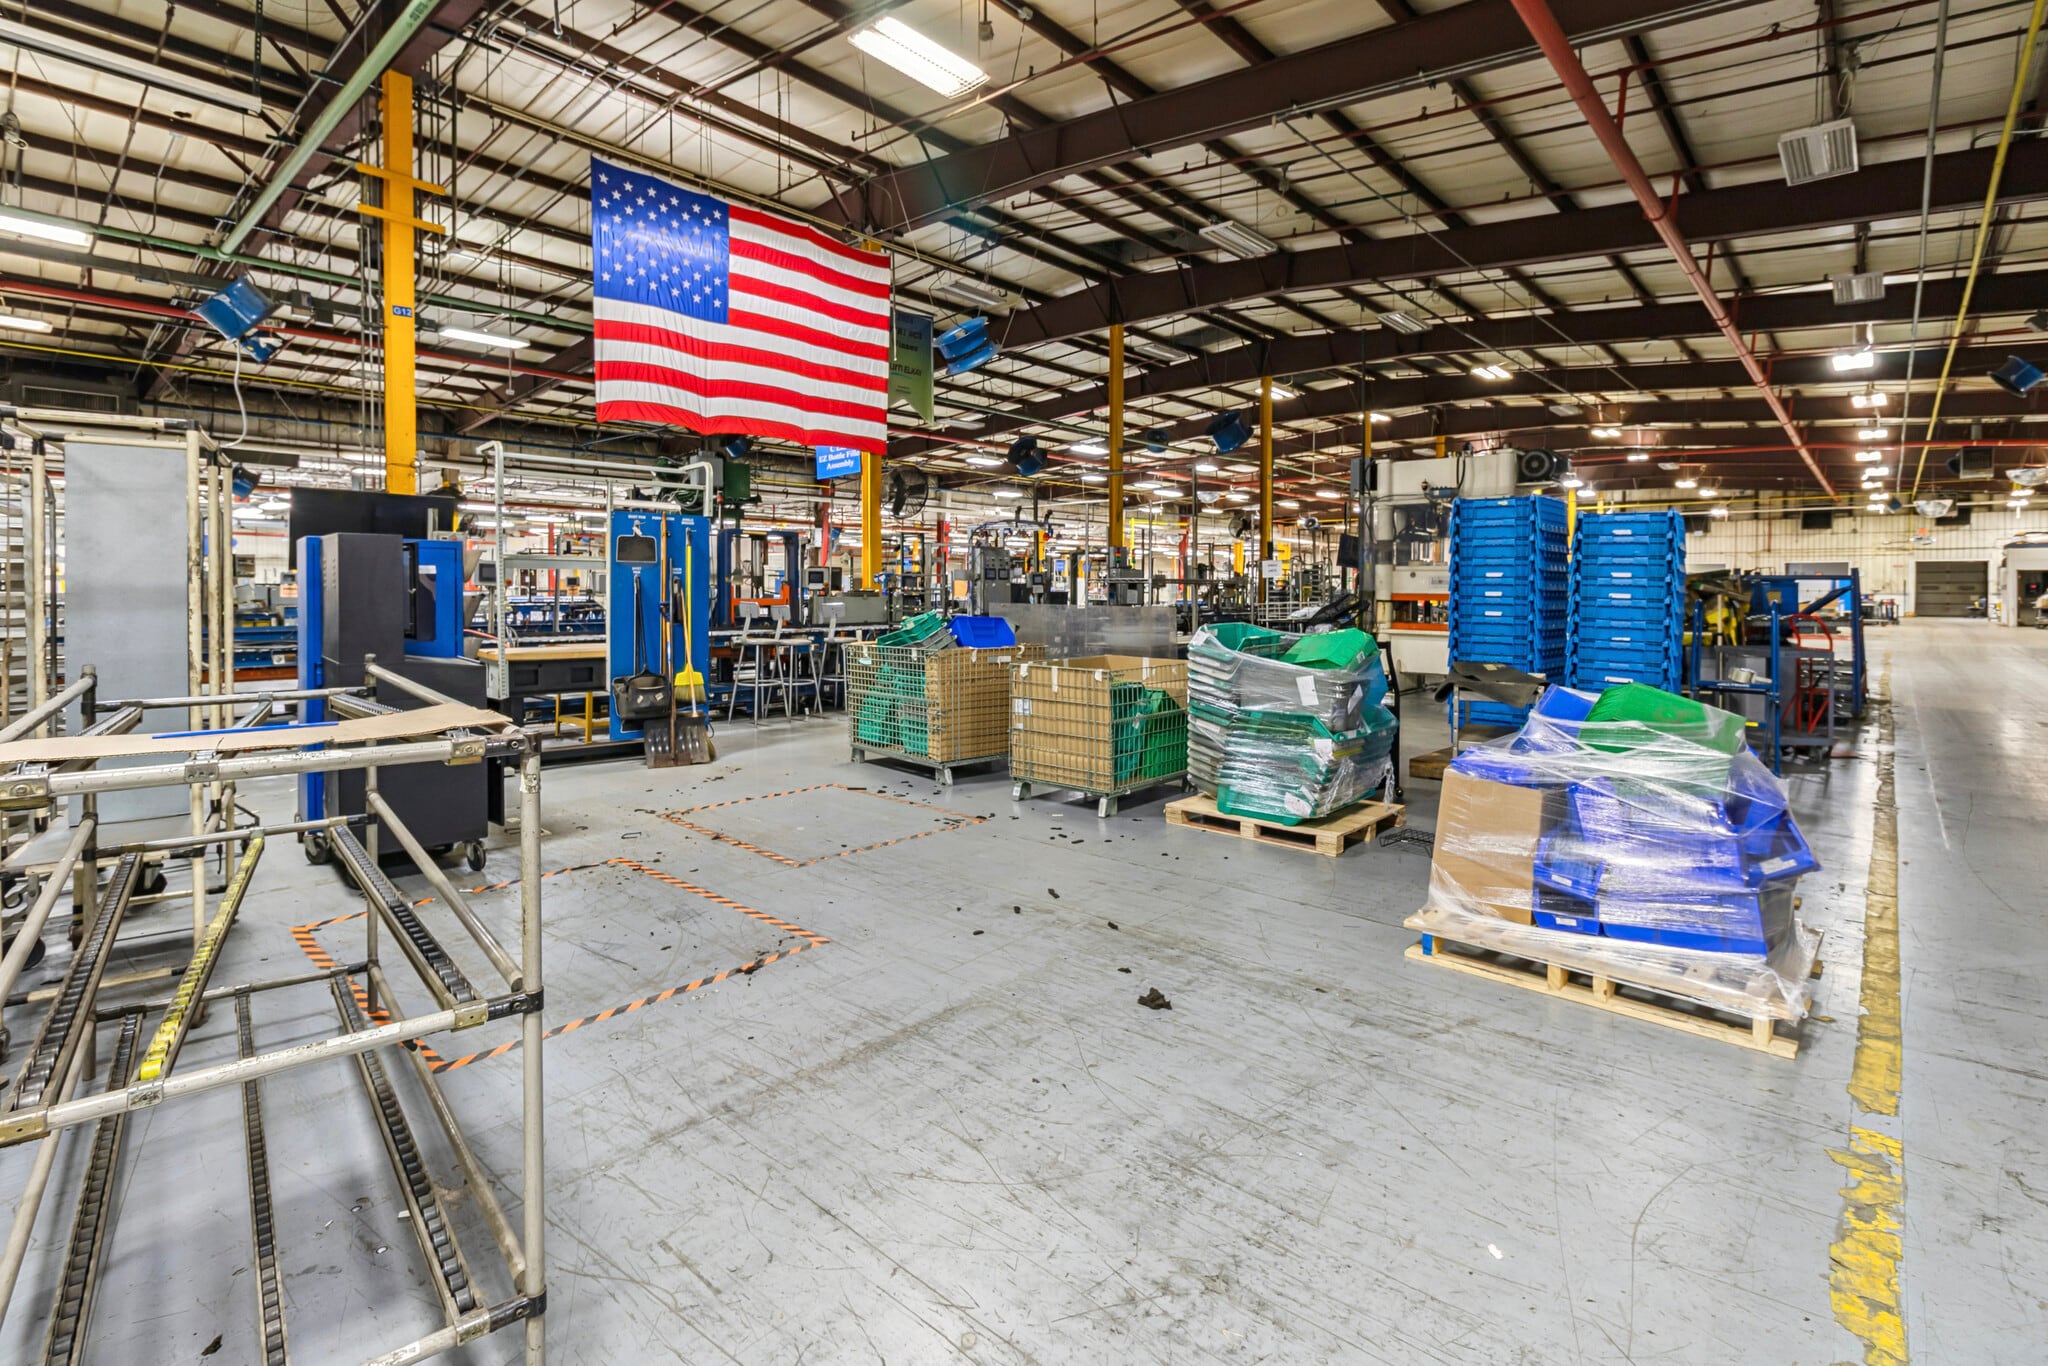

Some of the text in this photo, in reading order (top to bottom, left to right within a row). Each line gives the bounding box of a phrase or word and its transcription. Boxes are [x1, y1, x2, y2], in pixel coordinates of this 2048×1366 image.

[393, 306, 411, 317] G12
[819, 455, 828, 463] EZ
[828, 452, 845, 461] Bottle
[826, 459, 854, 470] Assembly
